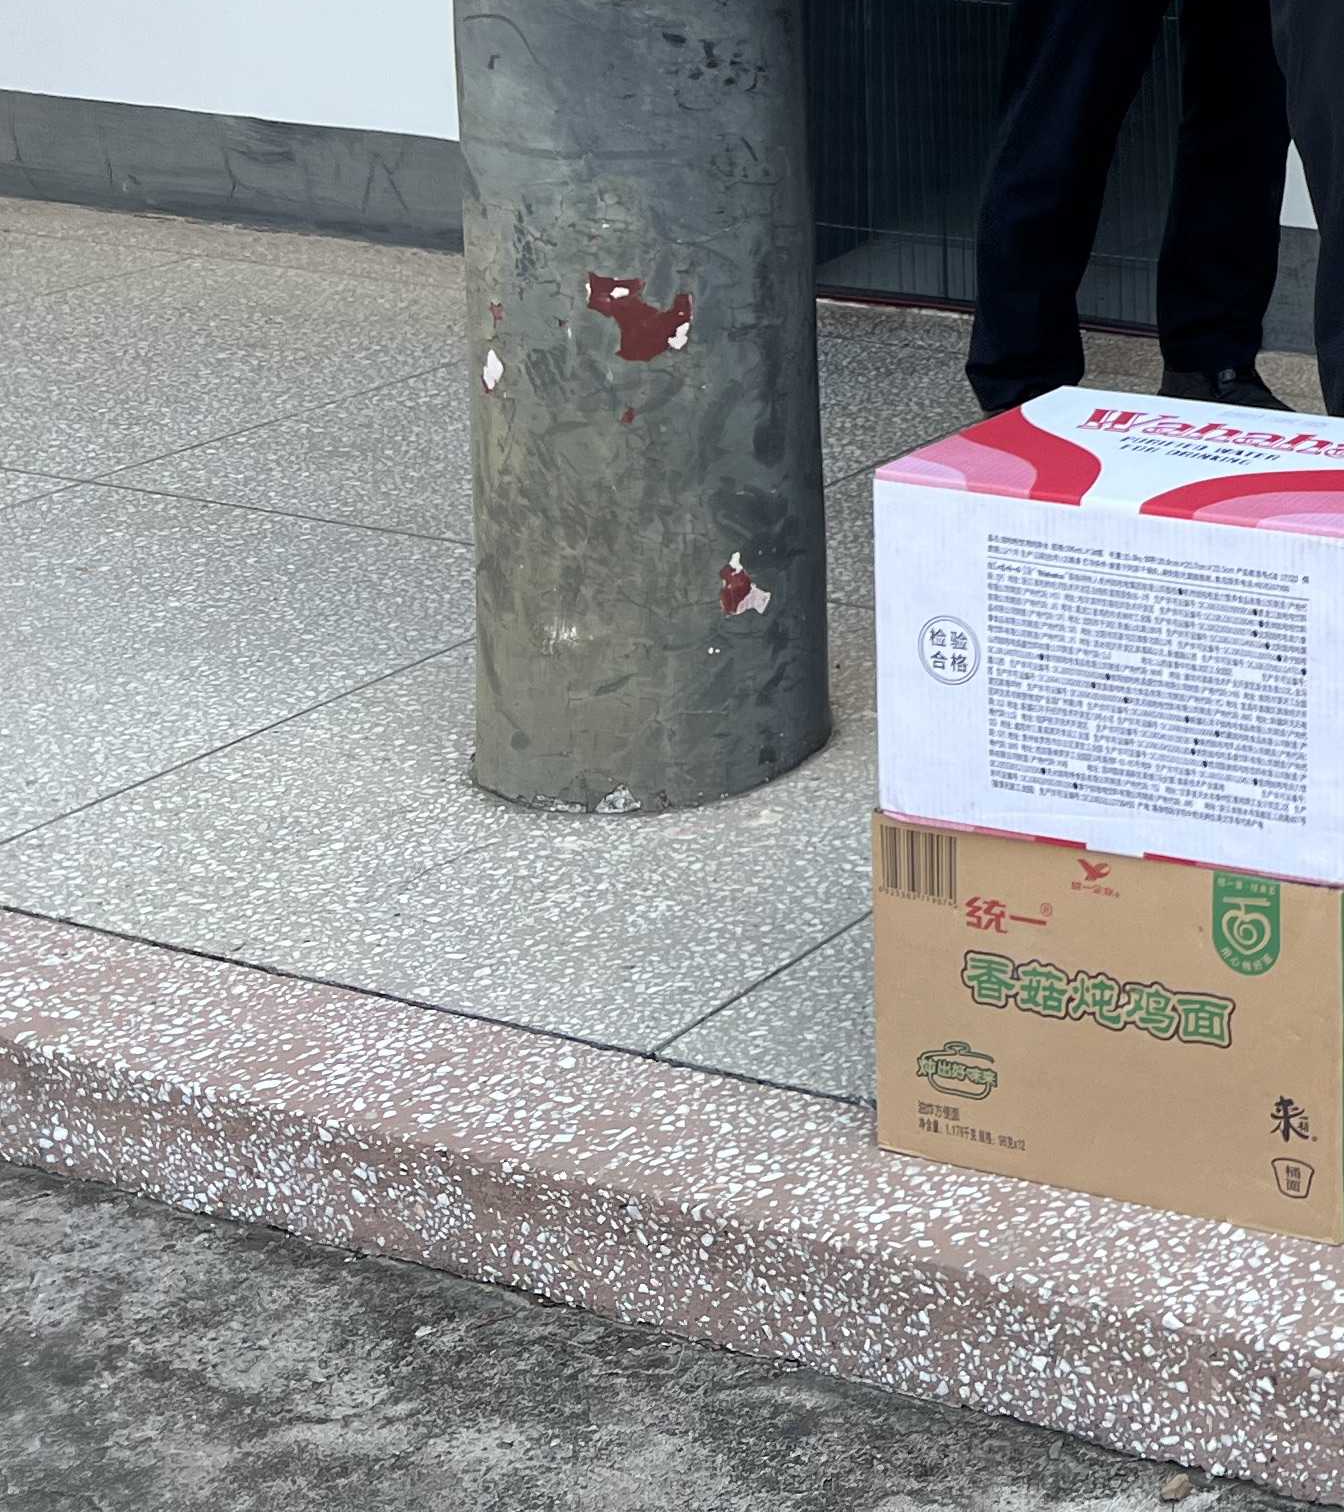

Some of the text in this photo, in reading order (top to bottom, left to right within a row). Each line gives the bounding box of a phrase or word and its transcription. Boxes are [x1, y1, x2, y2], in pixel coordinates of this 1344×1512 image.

[1120, 436, 1281, 461] PURIFIED WATER
[1120, 444, 1252, 465] FOR DRINKING
[929, 627, 968, 650] 检验
[930, 650, 968, 672] 合格
[964, 896, 1048, 934] 统一
[962, 950, 1235, 1048] 香菇炖鸡面
